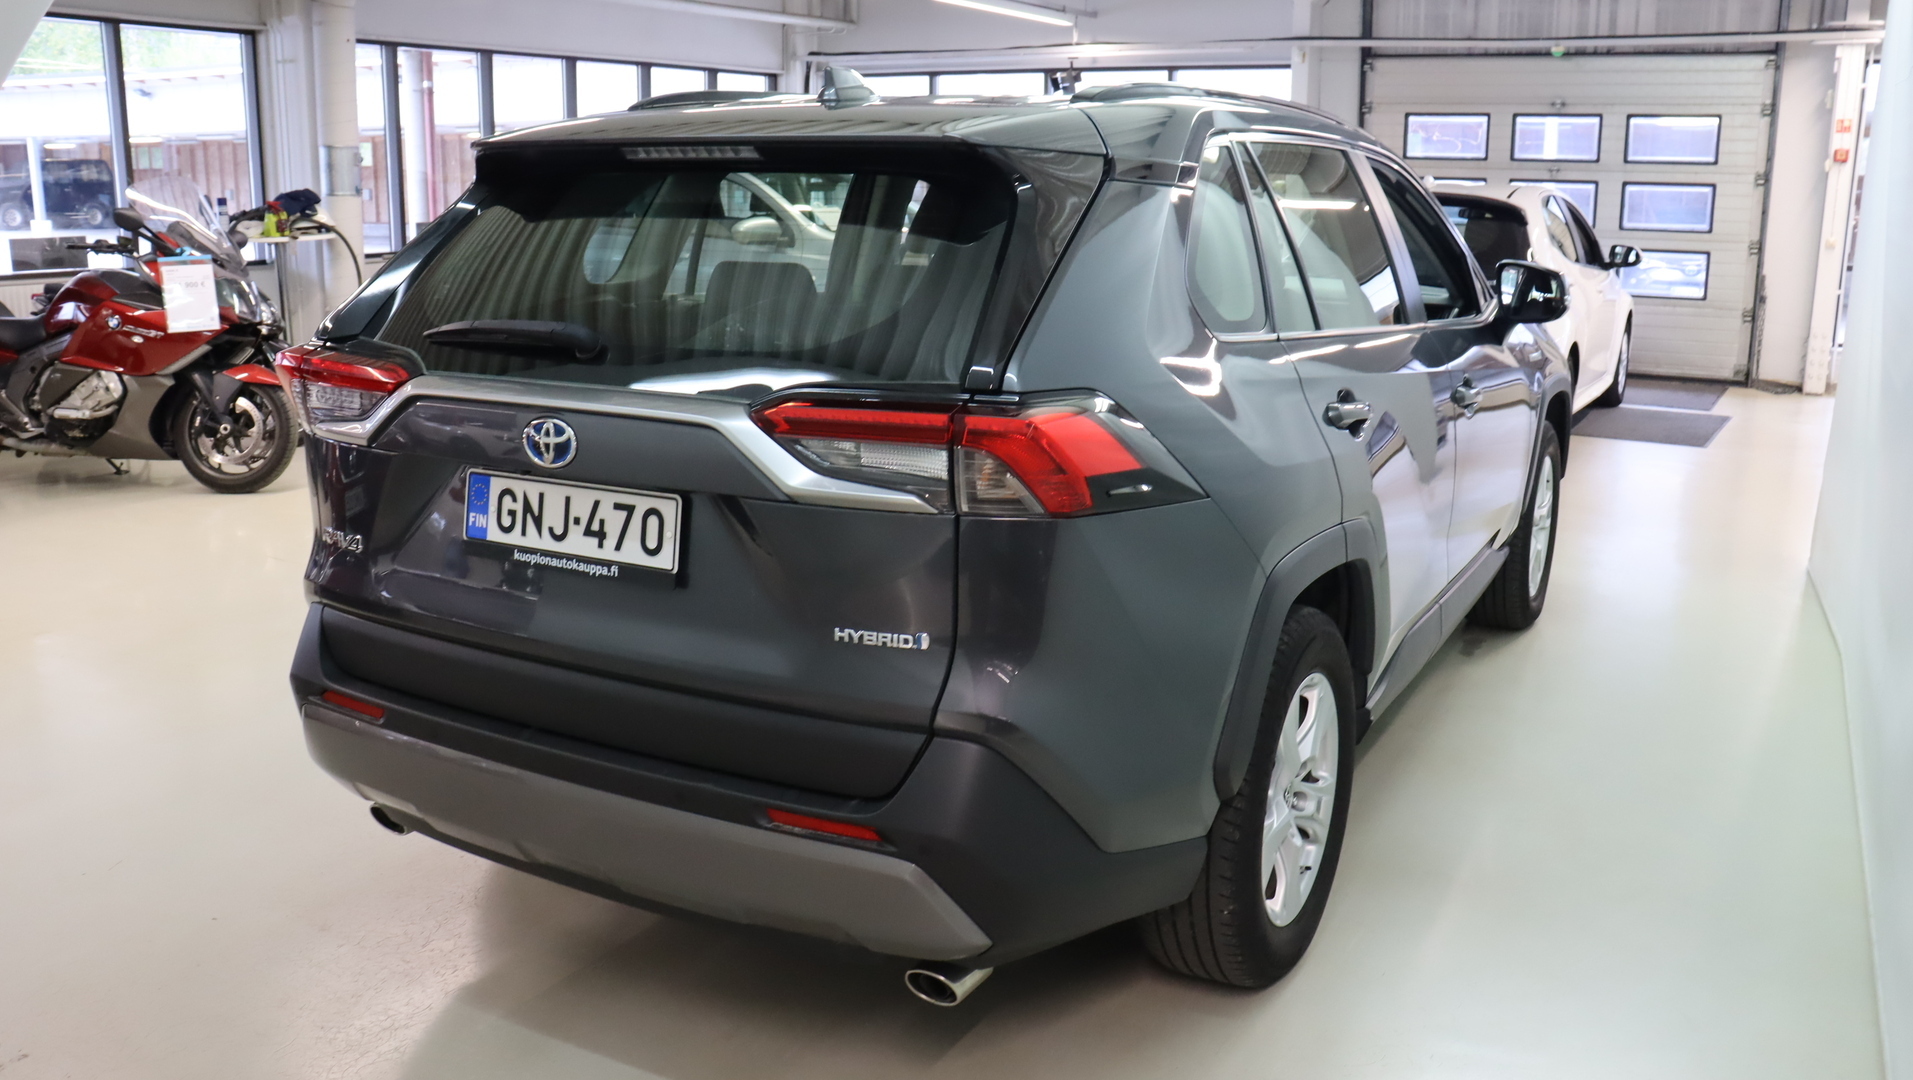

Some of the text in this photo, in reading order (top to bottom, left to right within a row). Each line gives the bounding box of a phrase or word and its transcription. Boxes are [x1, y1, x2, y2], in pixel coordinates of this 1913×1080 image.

[469, 488, 665, 557] FIN GNJ-470
[322, 527, 363, 554] RAV4
[514, 549, 619, 577] kuopionautokauppa.fi
[834, 627, 914, 649] HYBRID
